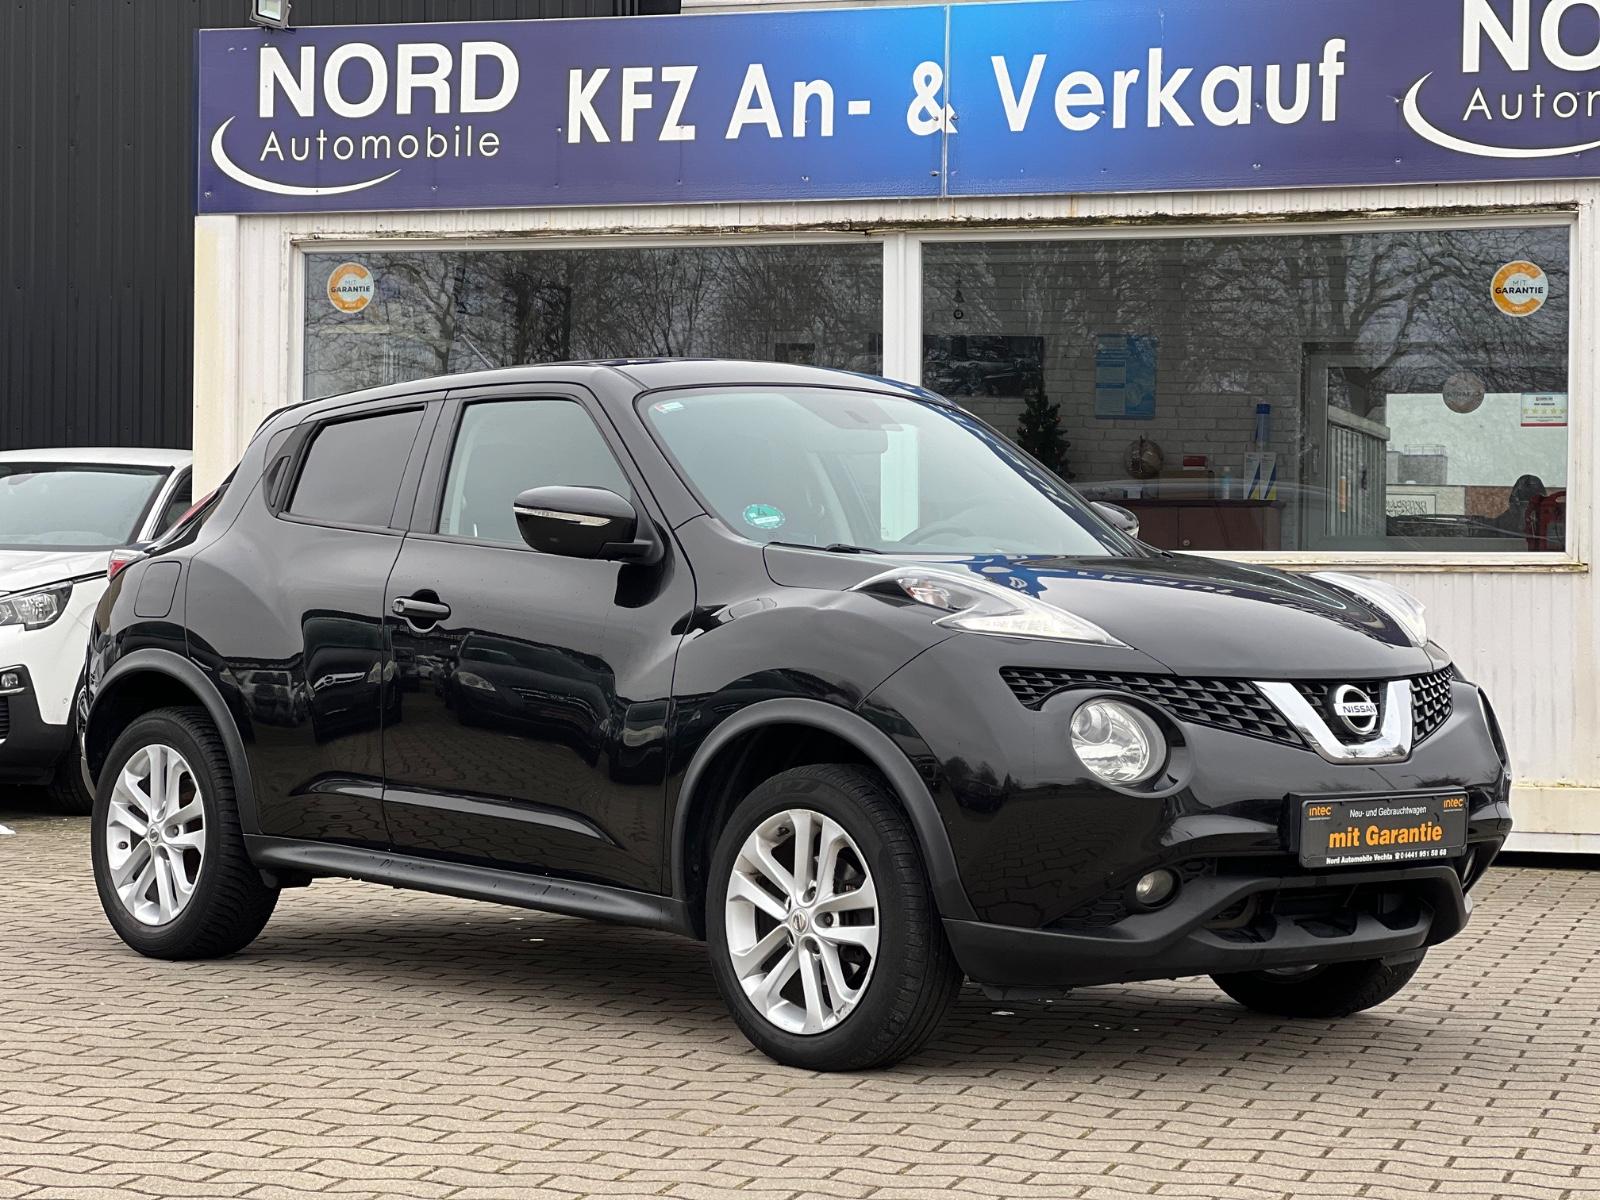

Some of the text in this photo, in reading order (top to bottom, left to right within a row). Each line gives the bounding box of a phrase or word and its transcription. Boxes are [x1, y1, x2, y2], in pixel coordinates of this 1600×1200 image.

[259, 41, 520, 118] NORD
[567, 38, 1346, 143] KFZ An- & Verkauf
[259, 125, 500, 161] Automobile
[1495, 286, 1544, 294] GARANTIE
[1343, 705, 1376, 713] NISSAN
[1350, 806, 1427, 818] Neu- und Gebrauchtwagen
[1329, 821, 1443, 849] mit Garantie
[1326, 857, 1340, 865] Nord
[1341, 855, 1373, 864] Automobile
[1374, 853, 1393, 861] Vechta
